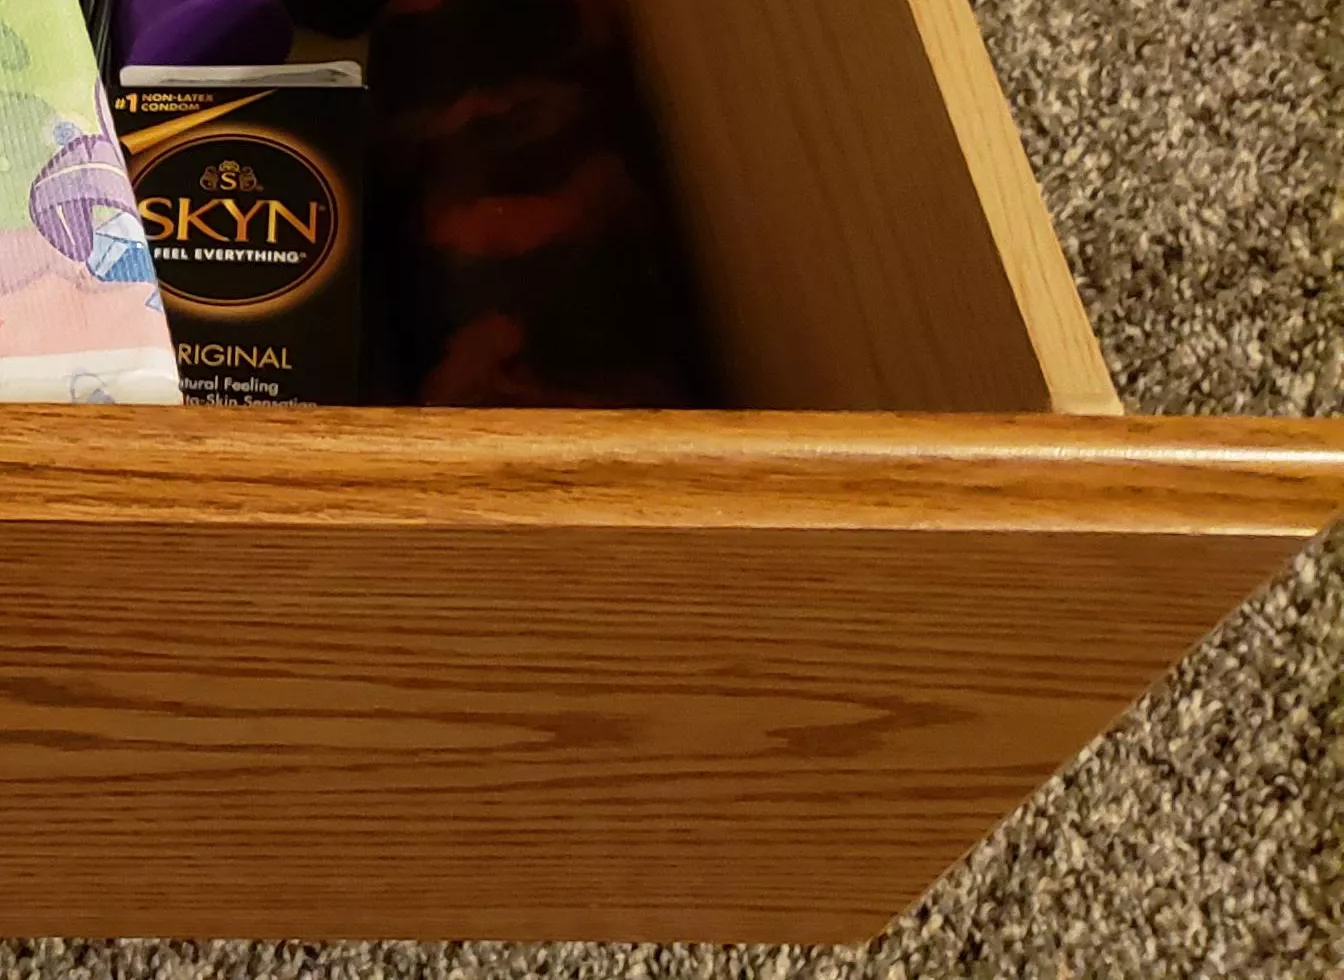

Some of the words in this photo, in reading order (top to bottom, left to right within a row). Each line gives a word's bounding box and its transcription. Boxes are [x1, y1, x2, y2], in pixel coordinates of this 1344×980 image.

[115, 92, 139, 114] #1
[140, 102, 201, 113] CONDOM
[141, 93, 214, 103] NON-LATEX
[219, 171, 238, 191] S
[137, 196, 318, 245] SKYN
[153, 246, 188, 261] FEEL
[177, 342, 293, 370] RIGINAL
[224, 376, 279, 397] Feeling
